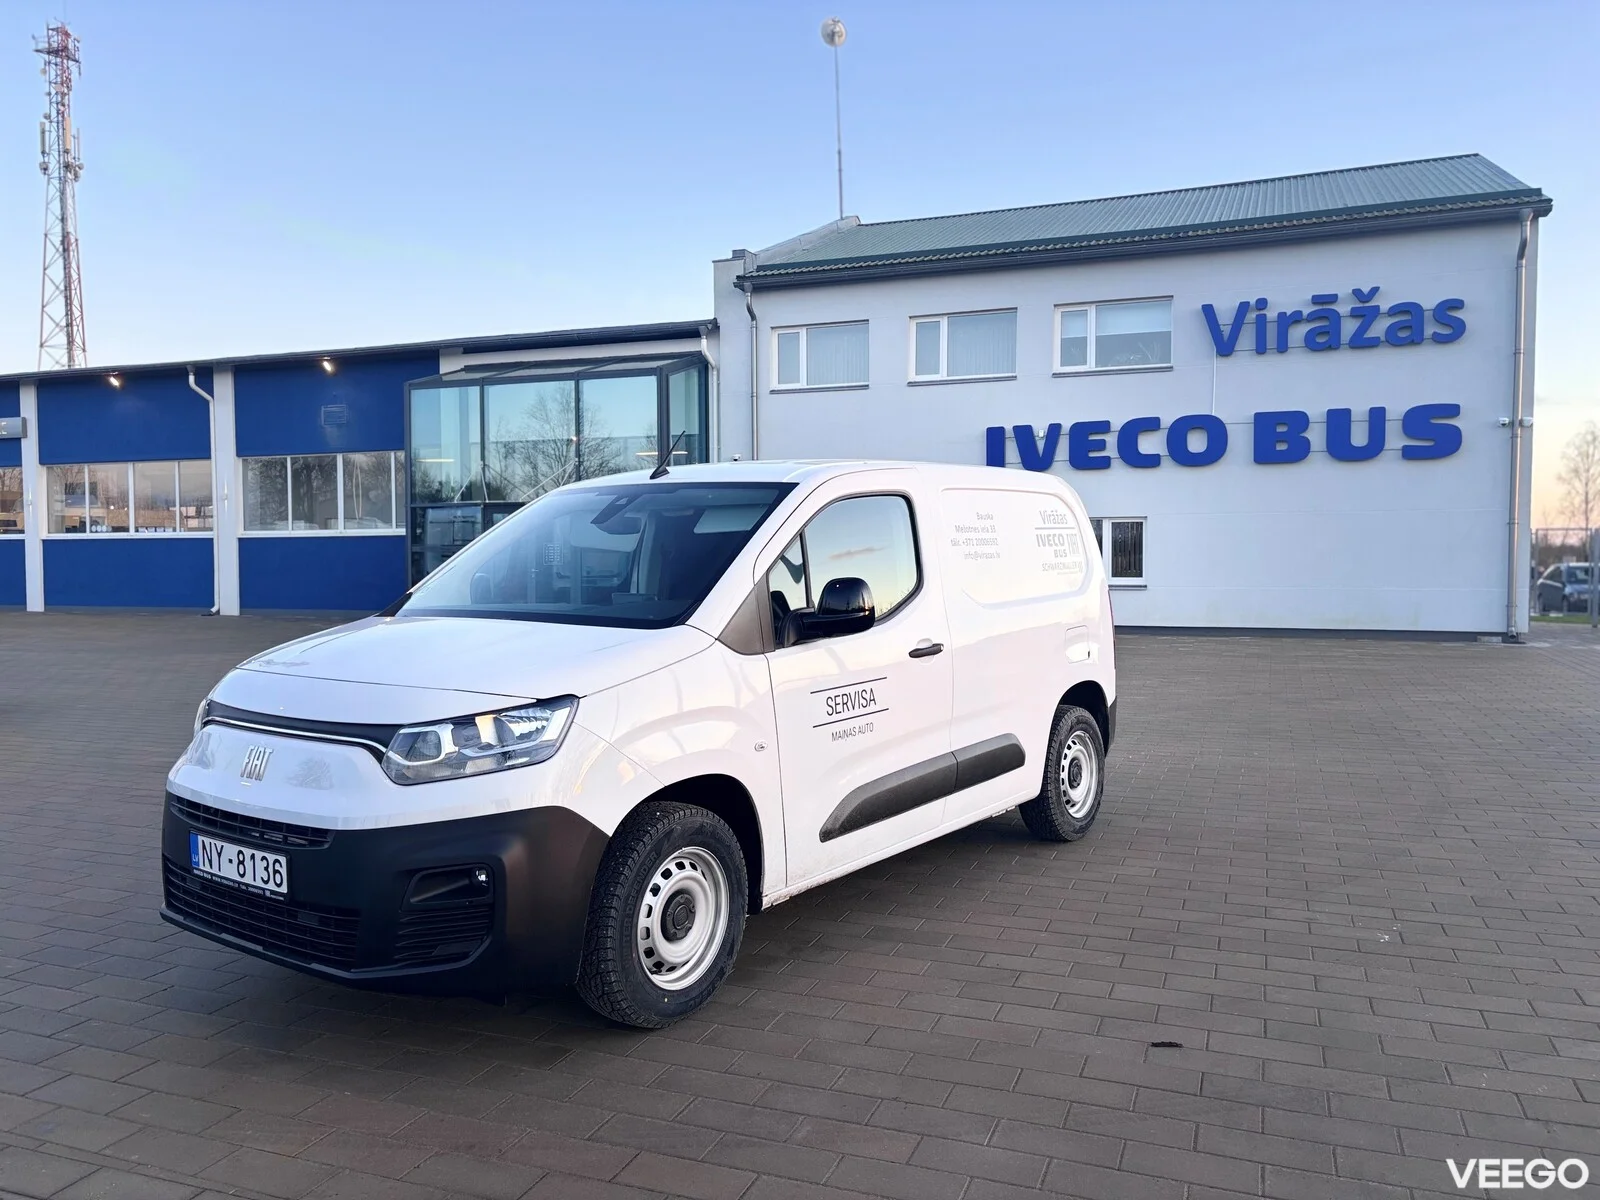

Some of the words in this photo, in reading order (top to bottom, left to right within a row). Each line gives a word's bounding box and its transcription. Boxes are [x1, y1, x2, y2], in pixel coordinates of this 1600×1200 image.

[1201, 286, 1466, 357] Virāžas
[986, 414, 1228, 471] IVECO
[1253, 403, 1463, 465] BUS
[962, 538, 974, 546] +371
[1036, 533, 1065, 547] IVECO
[1054, 549, 1067, 558] BUS
[826, 688, 876, 716] SERVISA
[858, 722, 874, 735] AUTO
[240, 745, 274, 781] FIAT
[201, 840, 284, 888] NY-8136
